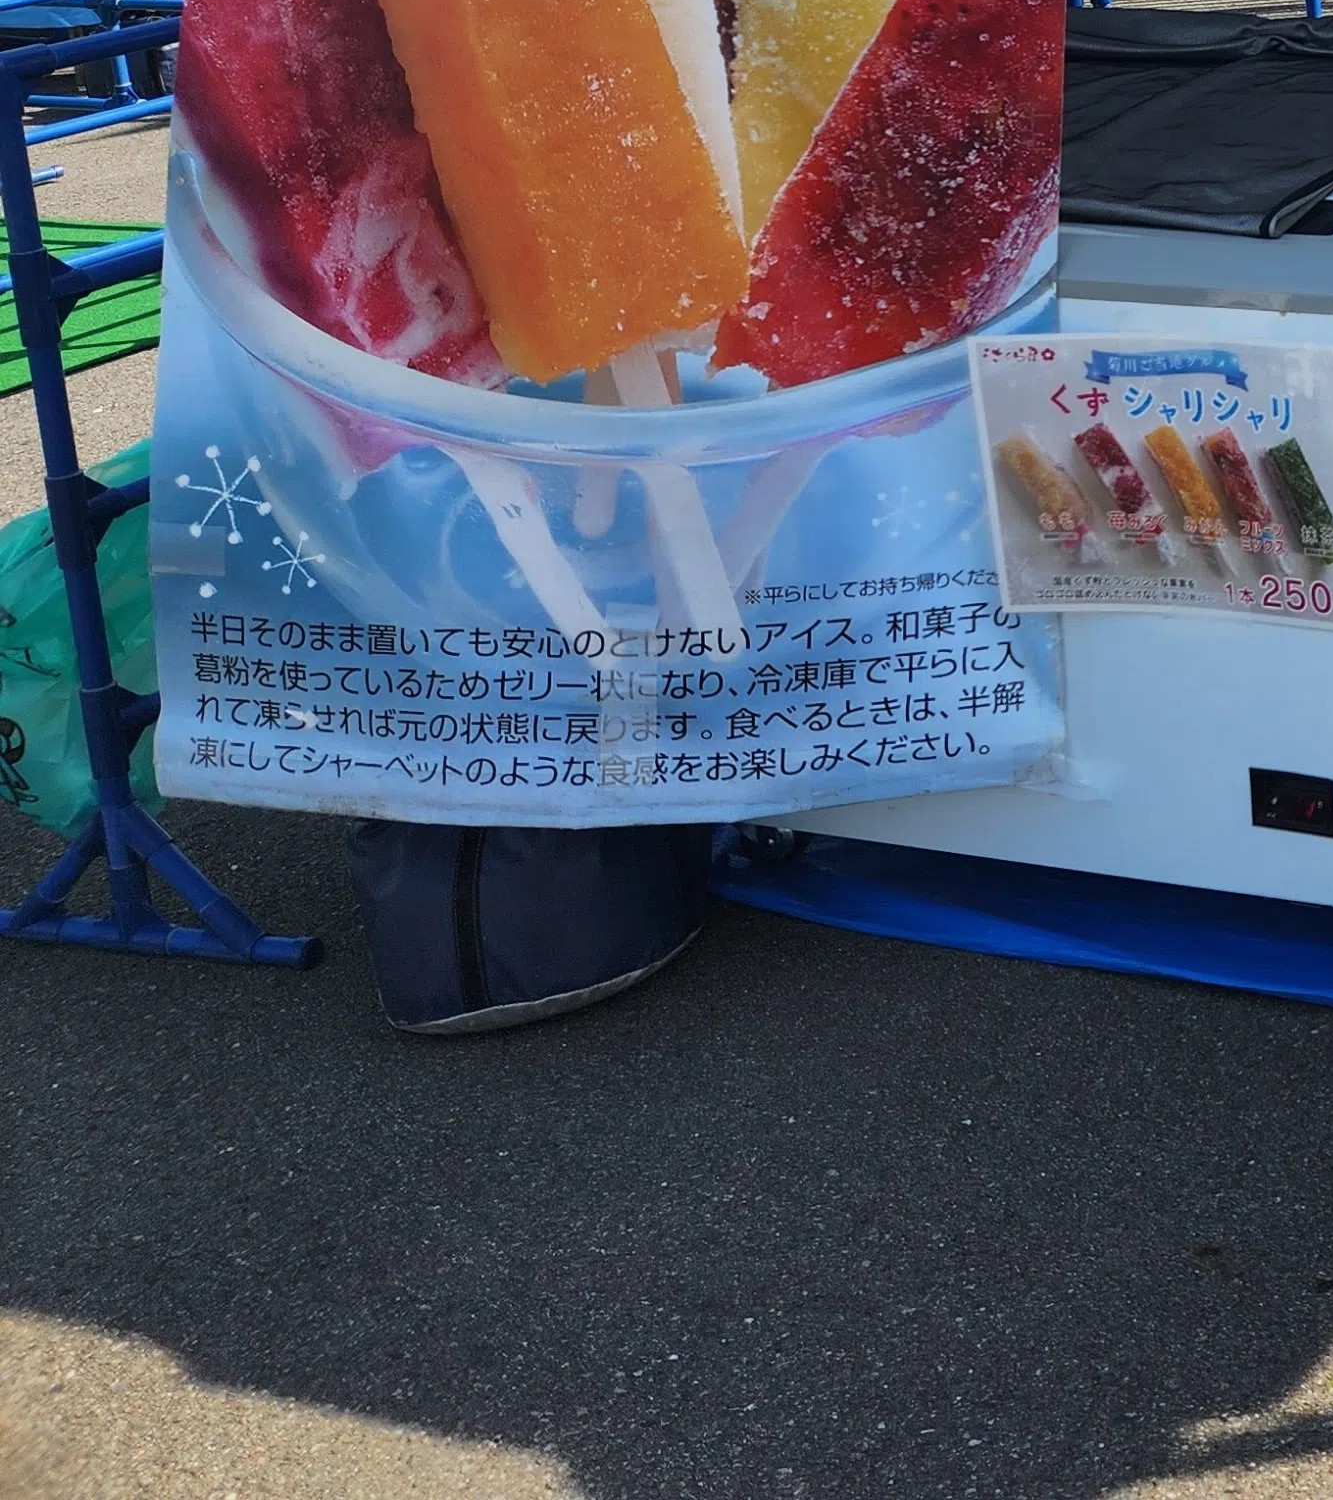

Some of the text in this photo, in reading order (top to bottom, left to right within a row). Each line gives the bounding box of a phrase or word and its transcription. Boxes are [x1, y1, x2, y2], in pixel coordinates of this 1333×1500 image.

[1050, 382, 1294, 432] くずシャリシャリ
[1239, 537, 1287, 554] ミックス
[1224, 582, 1256, 605] 1本
